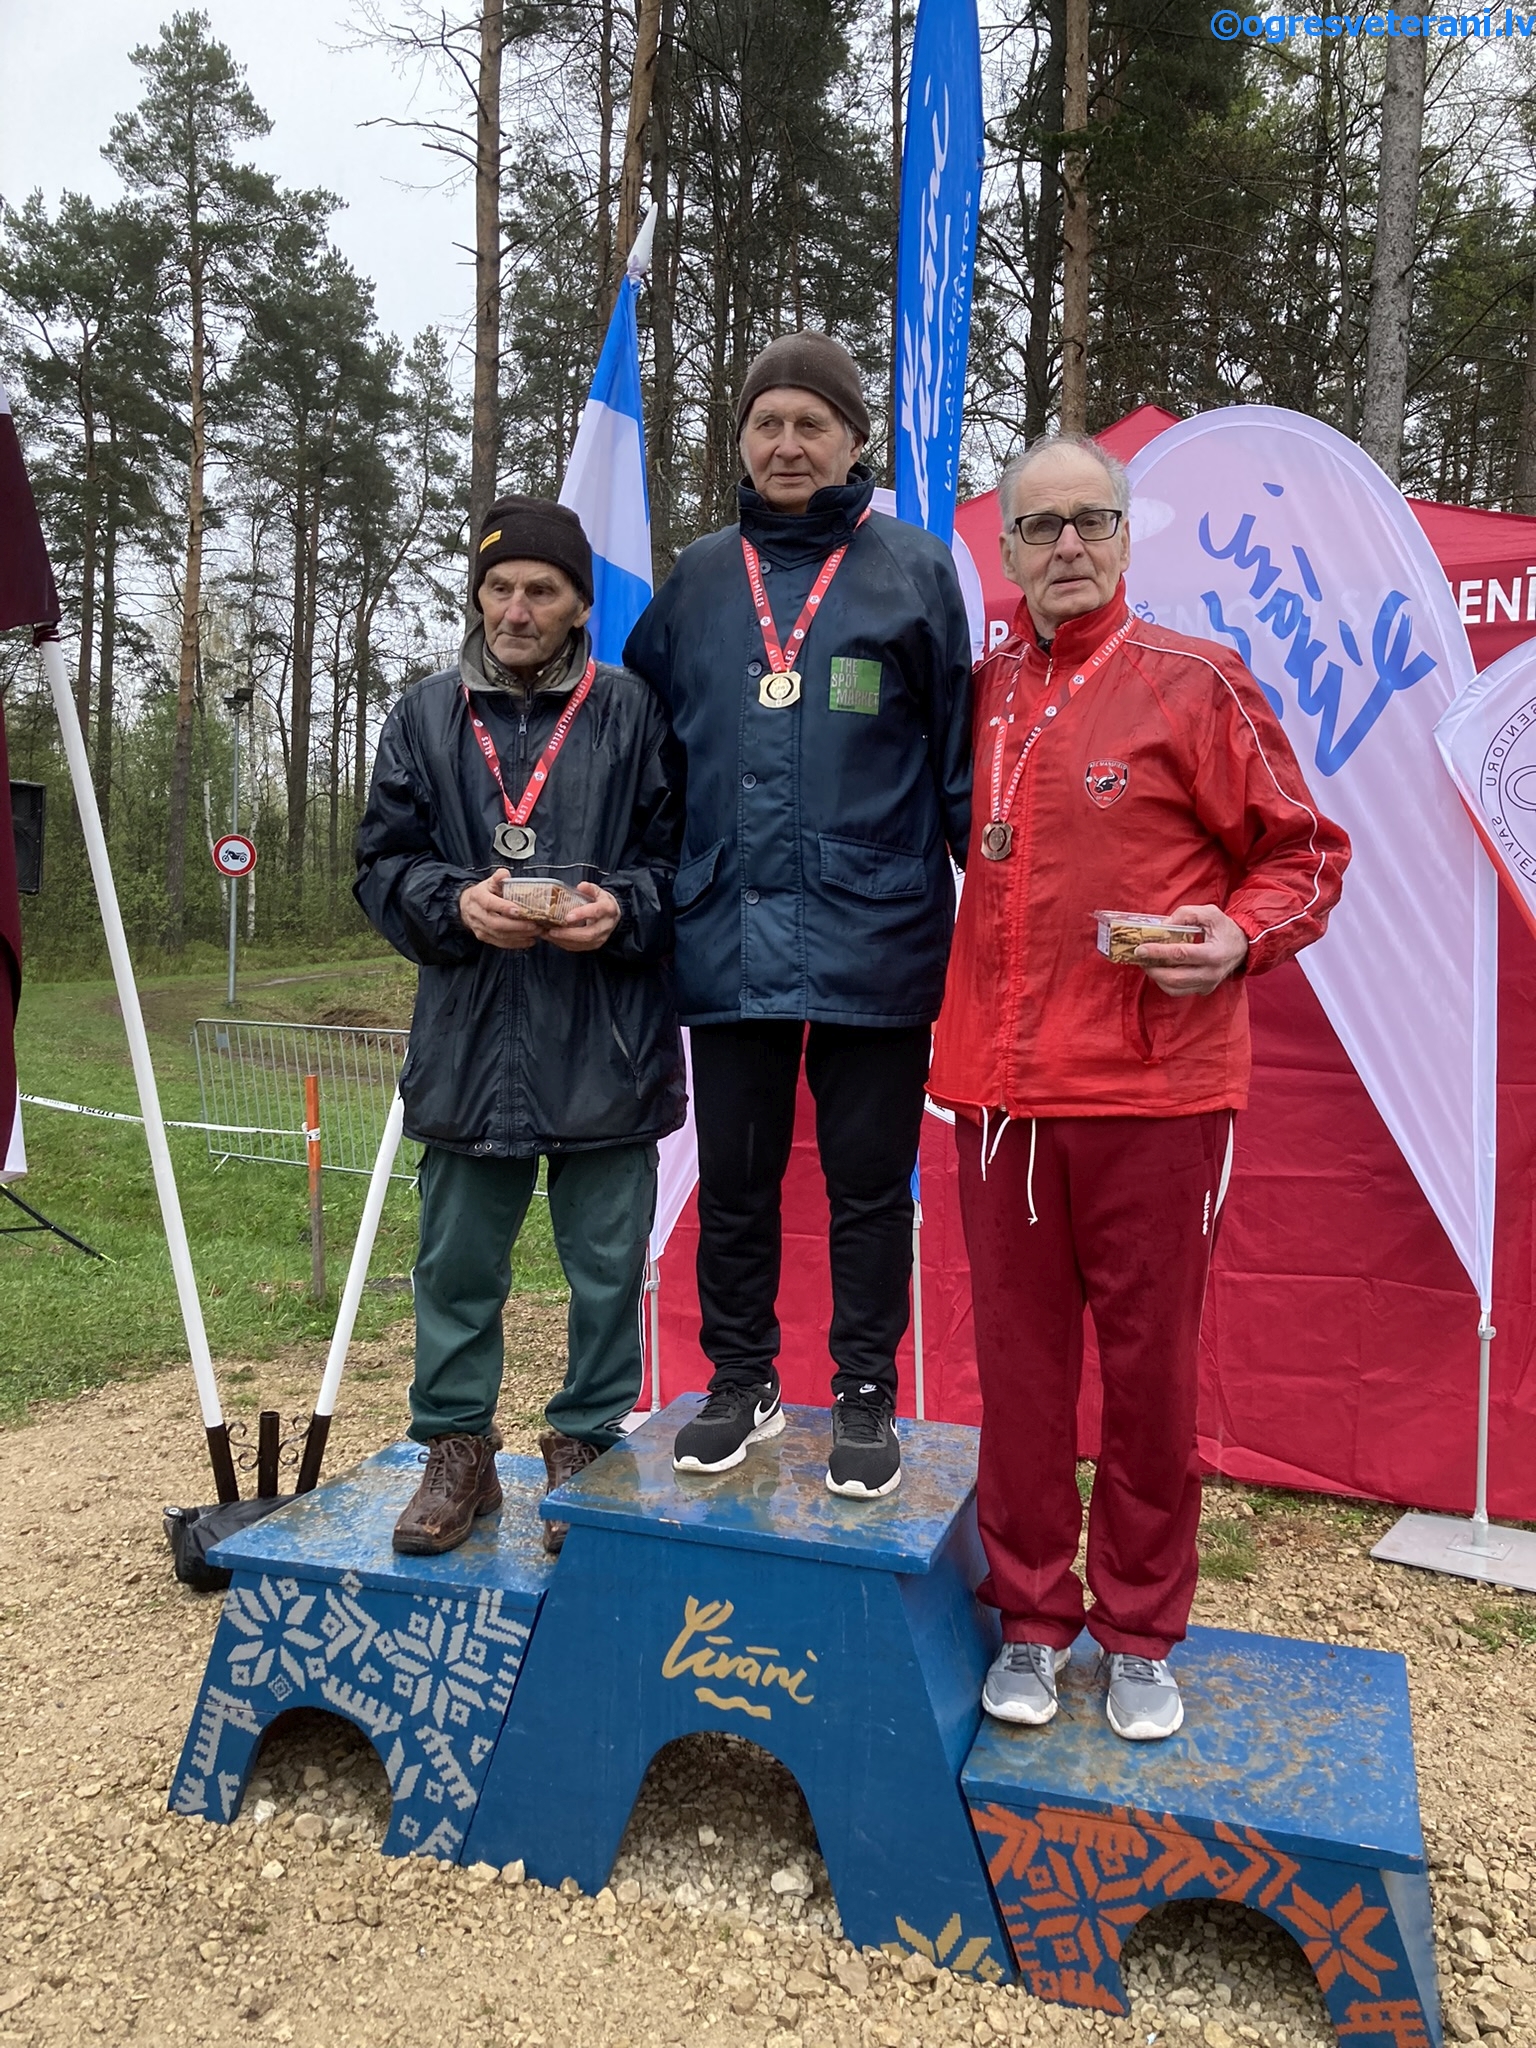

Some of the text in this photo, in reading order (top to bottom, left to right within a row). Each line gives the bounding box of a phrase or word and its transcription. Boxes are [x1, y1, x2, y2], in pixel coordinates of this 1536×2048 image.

[1102, 637, 1120, 656] LSVS
[839, 657, 858, 674] THE
[831, 672, 858, 688] SPOT
[836, 688, 879, 707] MARKET
[662, 1595, 818, 1705] Līvāni
